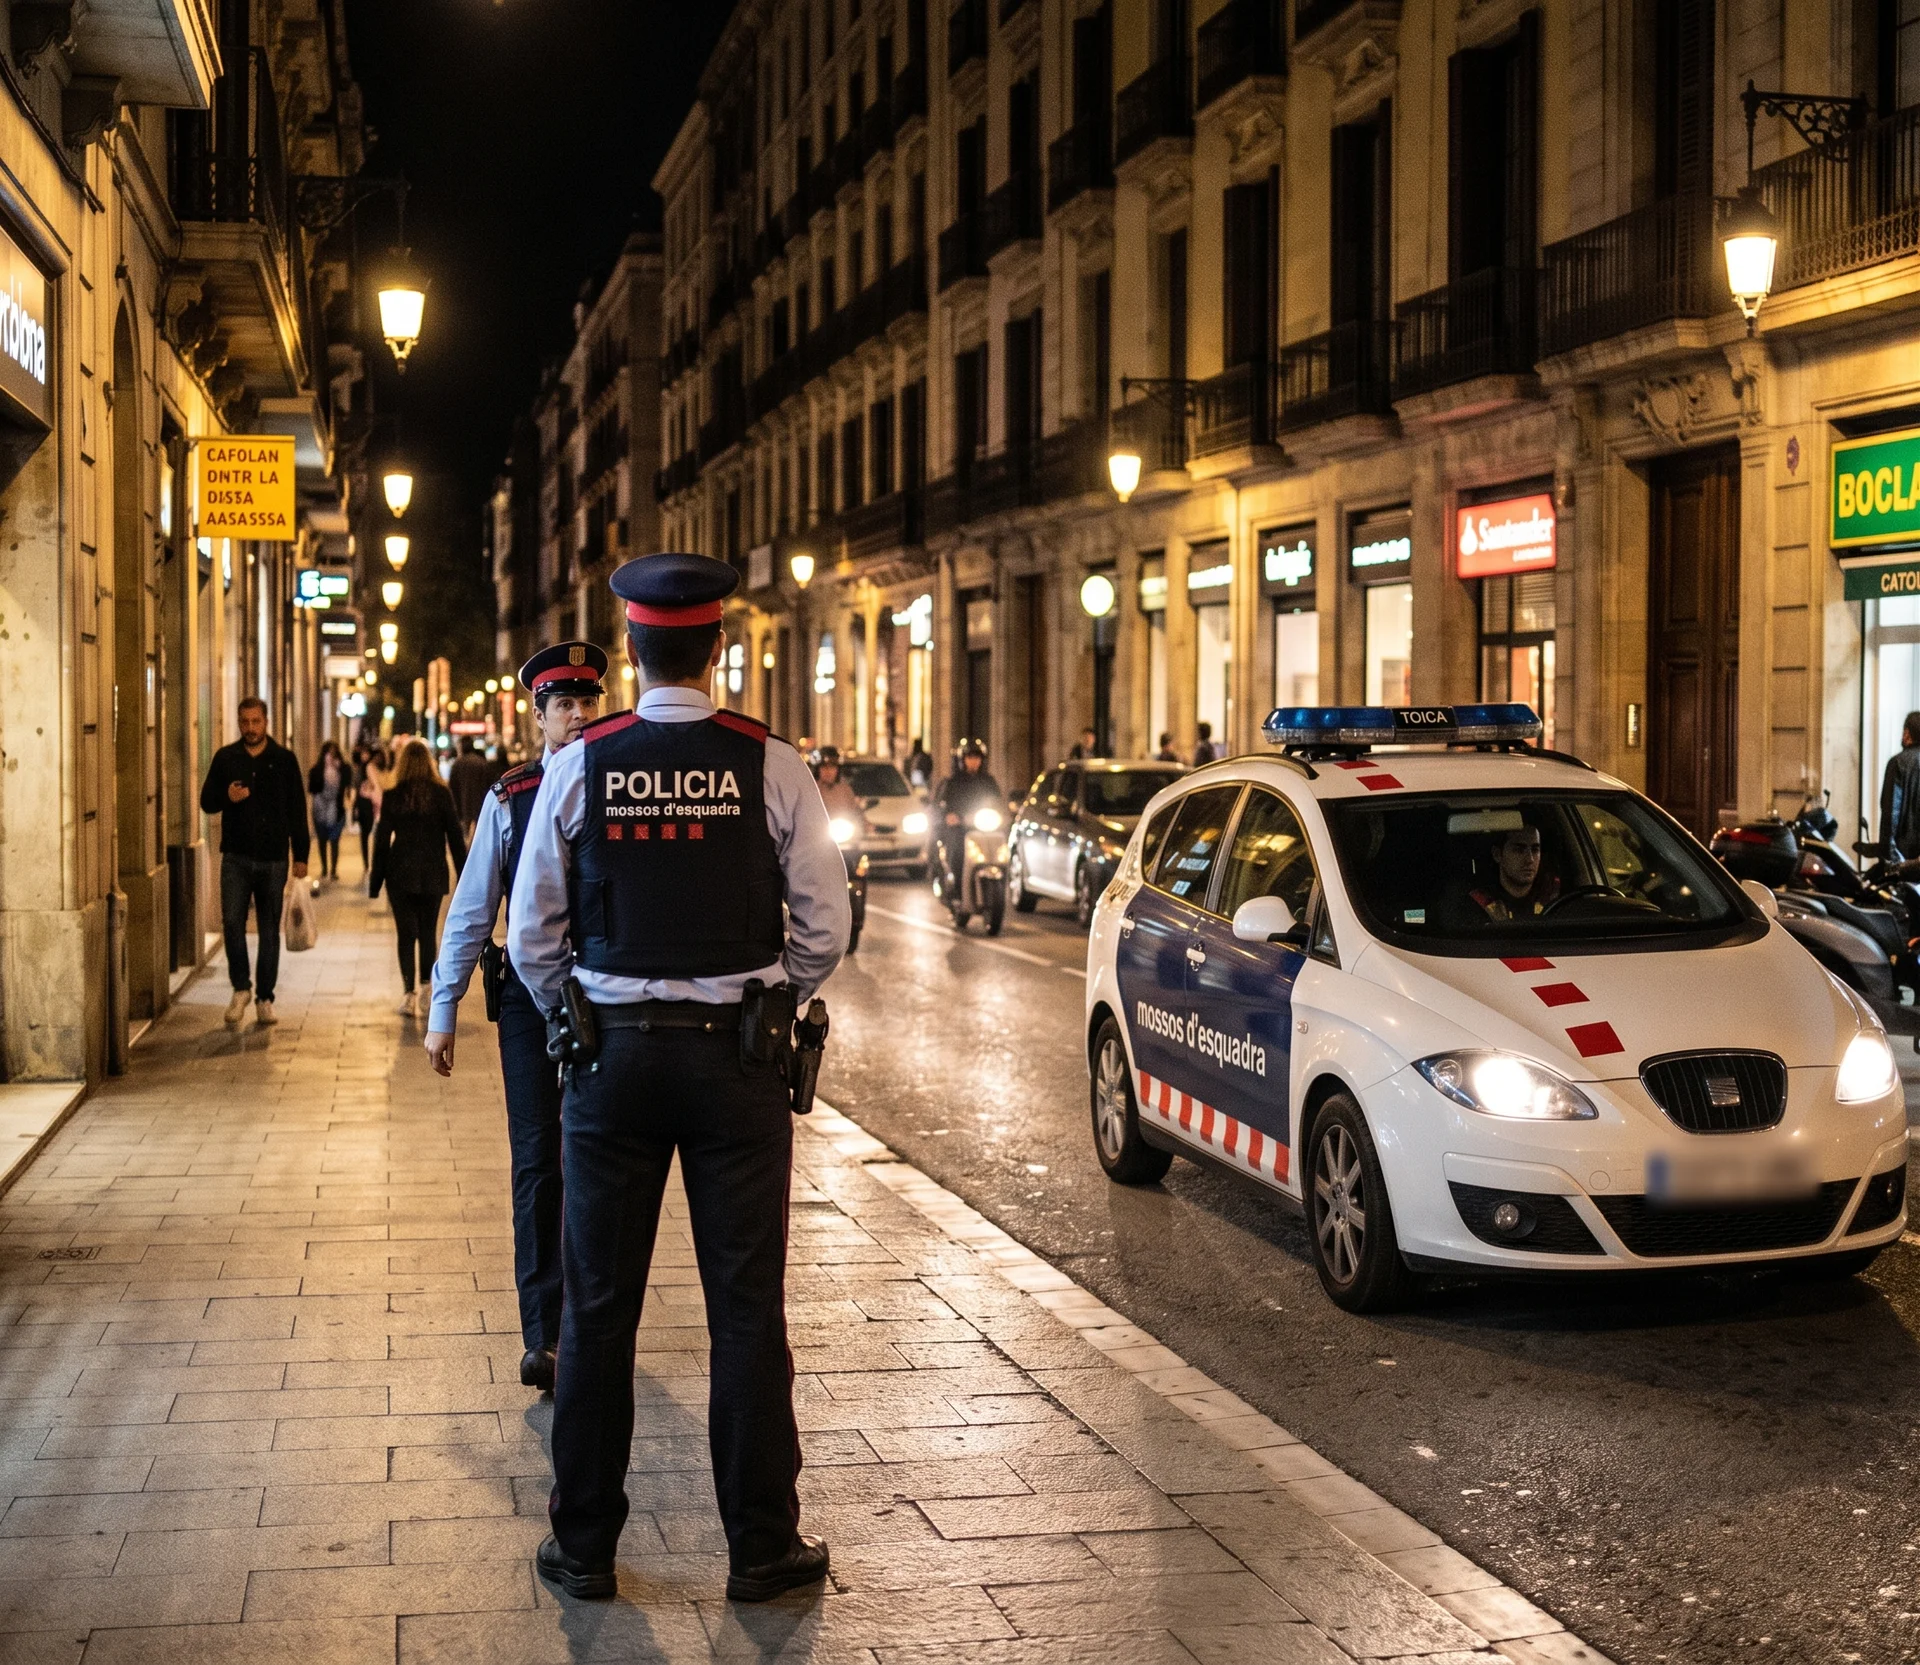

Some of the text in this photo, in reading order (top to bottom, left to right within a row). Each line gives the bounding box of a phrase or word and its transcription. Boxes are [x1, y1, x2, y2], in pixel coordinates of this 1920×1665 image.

[207, 448, 279, 463] CAFOLAN
[259, 470, 279, 485] LA
[206, 511, 287, 526] AASASSSA
[1400, 710, 1448, 724] TOICA
[606, 770, 741, 800] POLICIA
[606, 802, 741, 819] mossos d'esquadra
[1137, 1000, 1267, 1078] mossos d'esquadra
